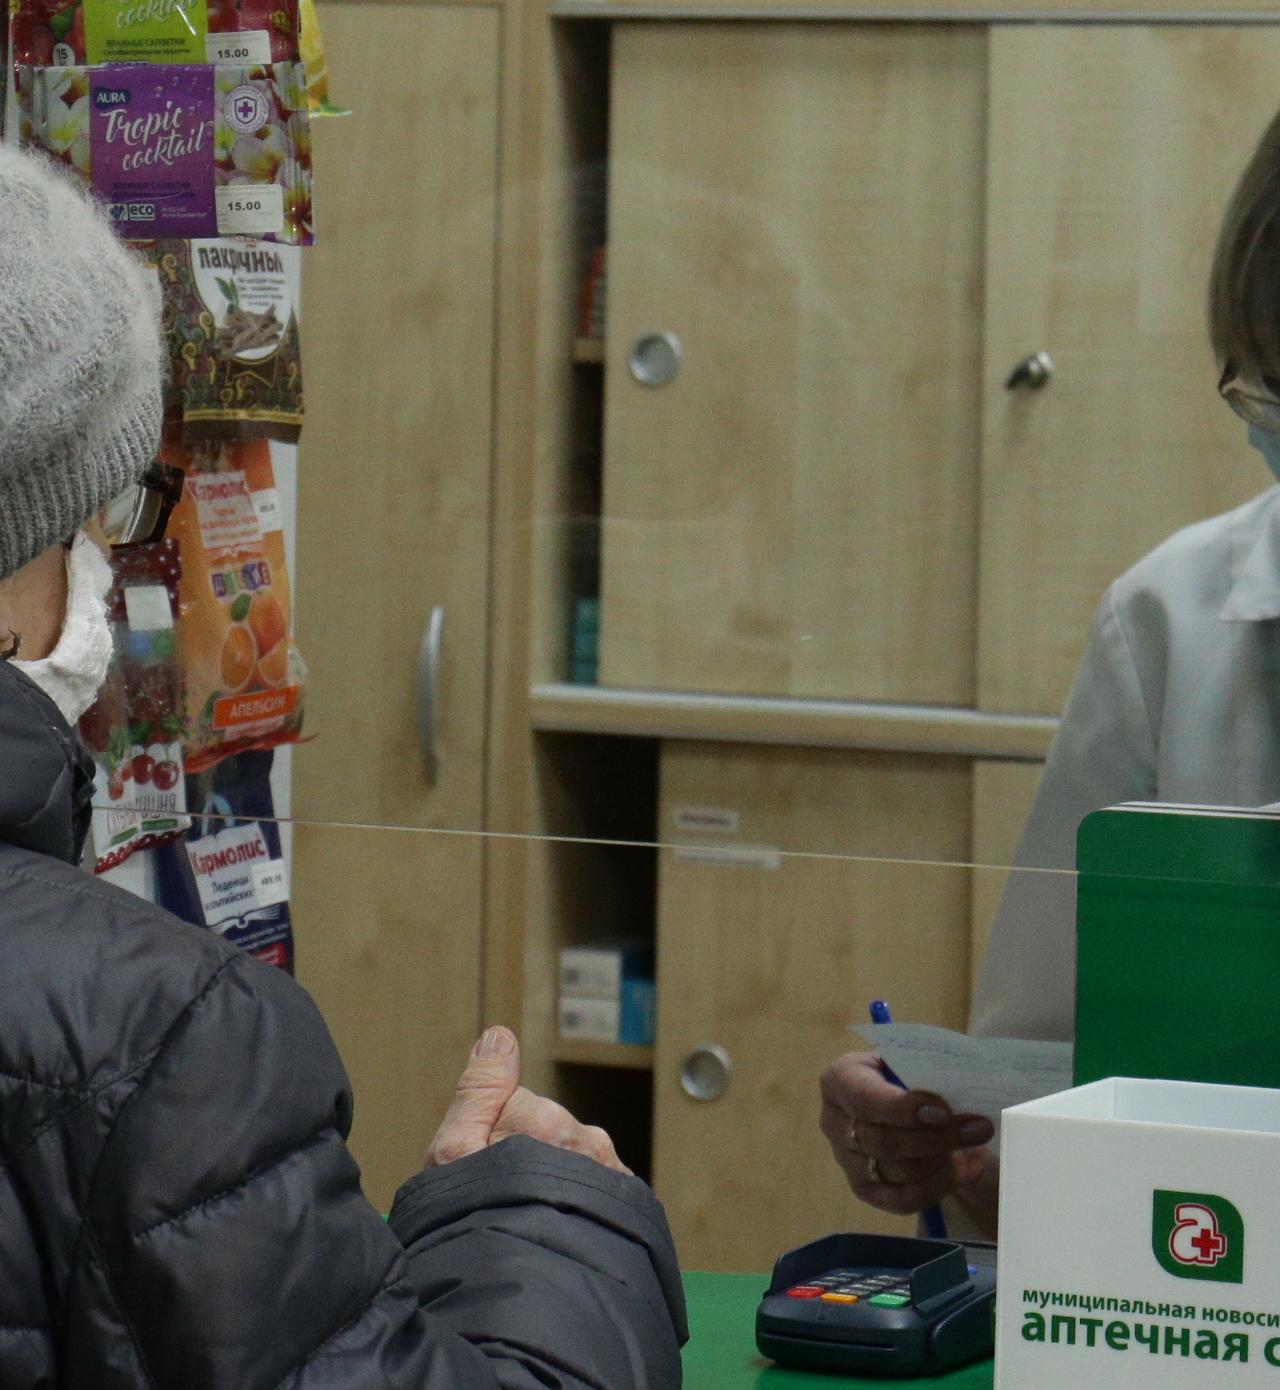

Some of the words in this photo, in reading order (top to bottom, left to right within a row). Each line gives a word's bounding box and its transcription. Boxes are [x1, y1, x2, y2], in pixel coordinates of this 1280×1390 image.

[56, 49, 68, 59] 15
[217, 48, 249, 59] 15.00
[96, 91, 127, 104] AURA
[100, 101, 183, 147] Tropic
[122, 120, 211, 171] cocktail
[130, 204, 155, 216] eco
[227, 200, 262, 211] 15.00
[229, 694, 286, 720] АПЕЛЬСИН
[189, 837, 267, 877] Кармолис
[1022, 1288, 1196, 1320] муниципальная
[1021, 1309, 1250, 1363] аптечная
